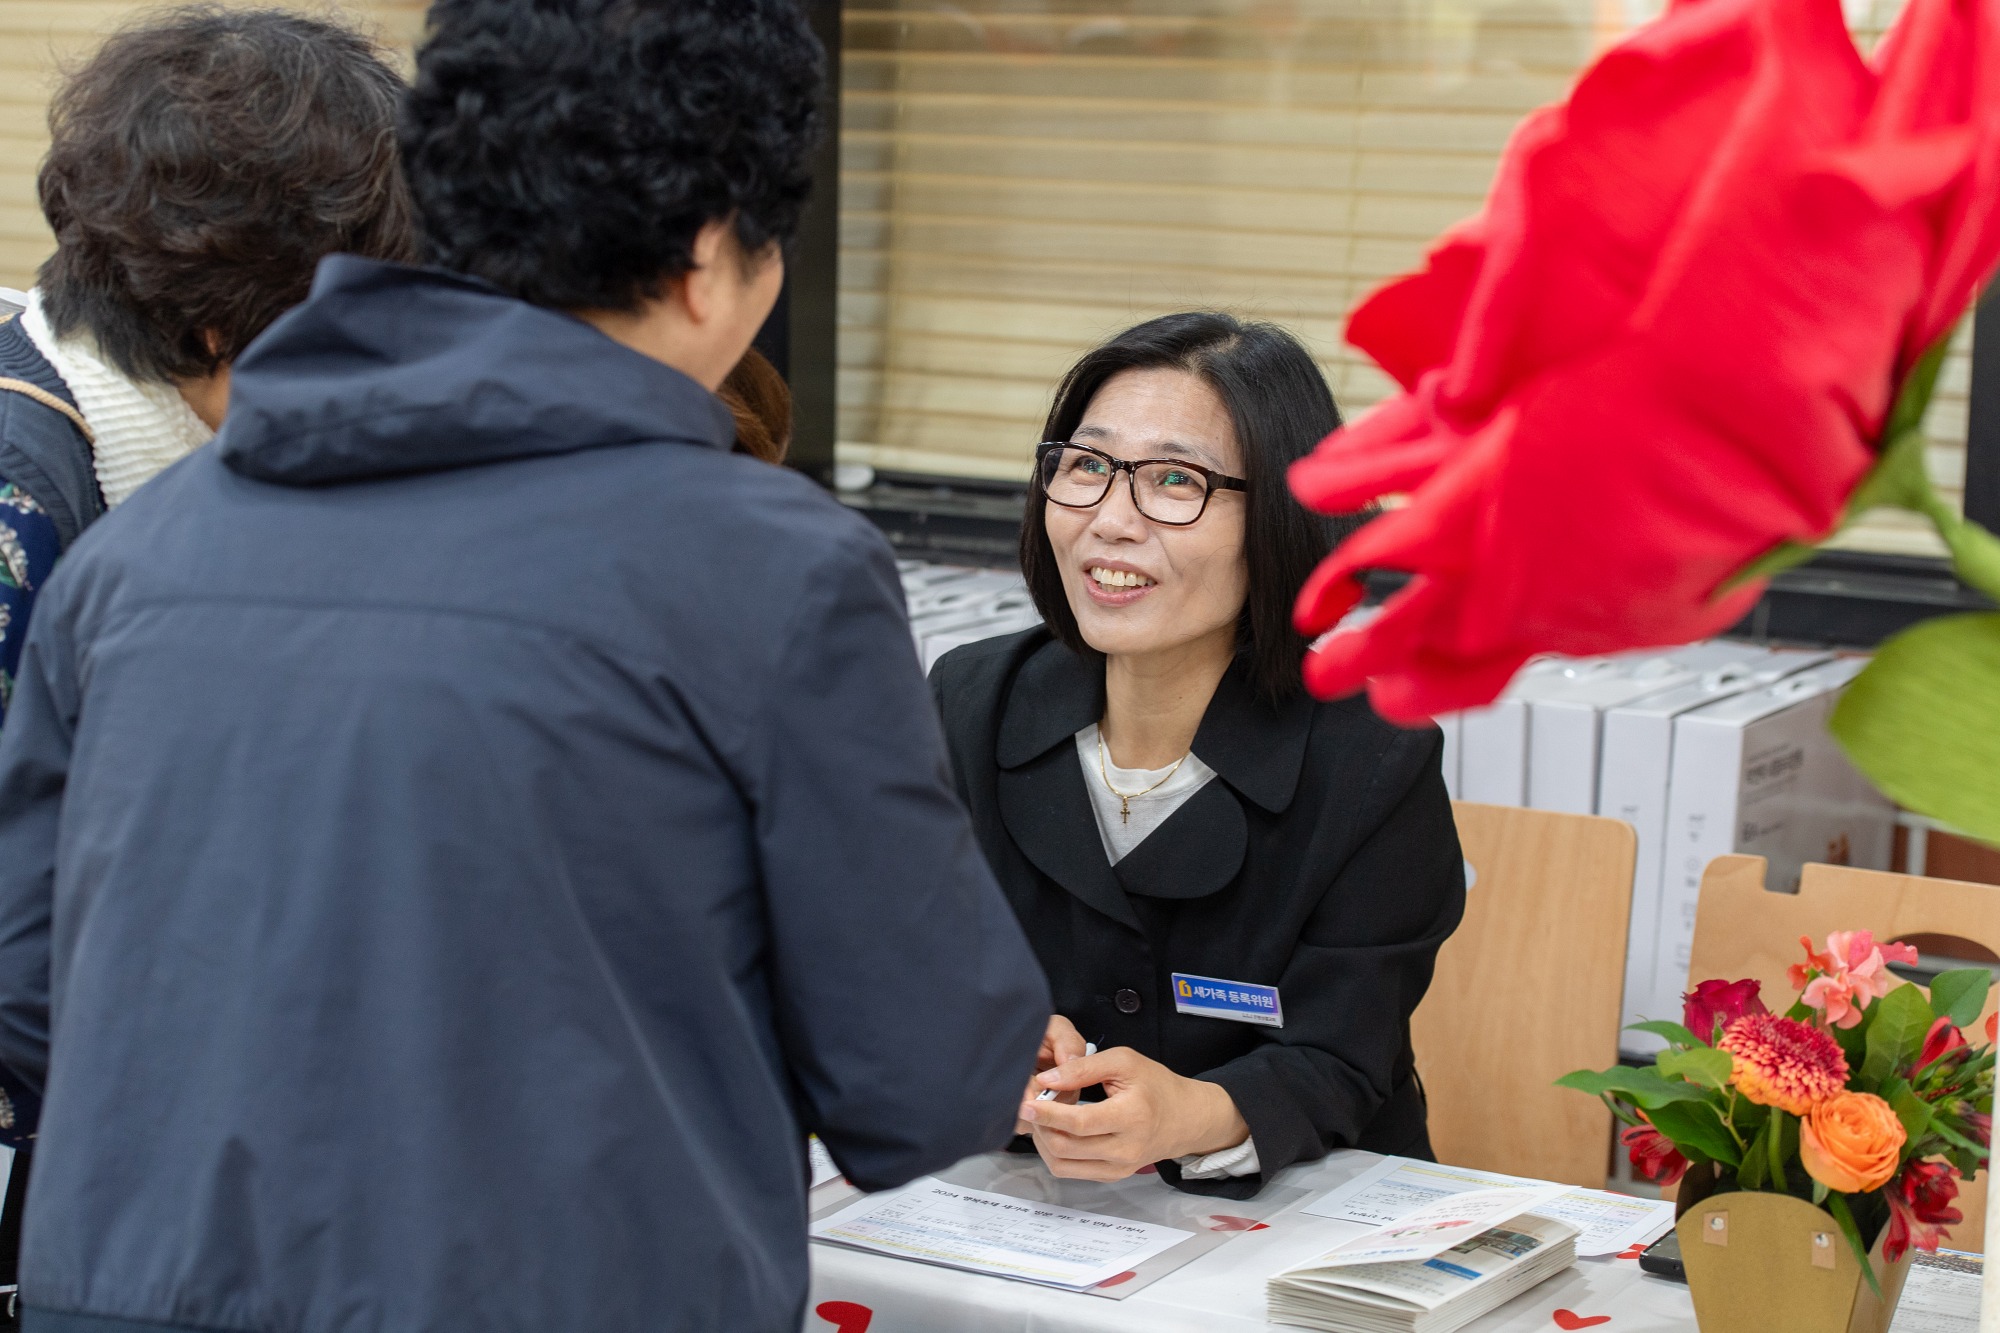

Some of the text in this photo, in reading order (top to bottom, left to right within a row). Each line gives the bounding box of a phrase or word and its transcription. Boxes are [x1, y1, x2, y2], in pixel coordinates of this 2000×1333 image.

[1194, 987, 1275, 1008] 새가족 등록위원
[932, 1189, 959, 1198] 2024
